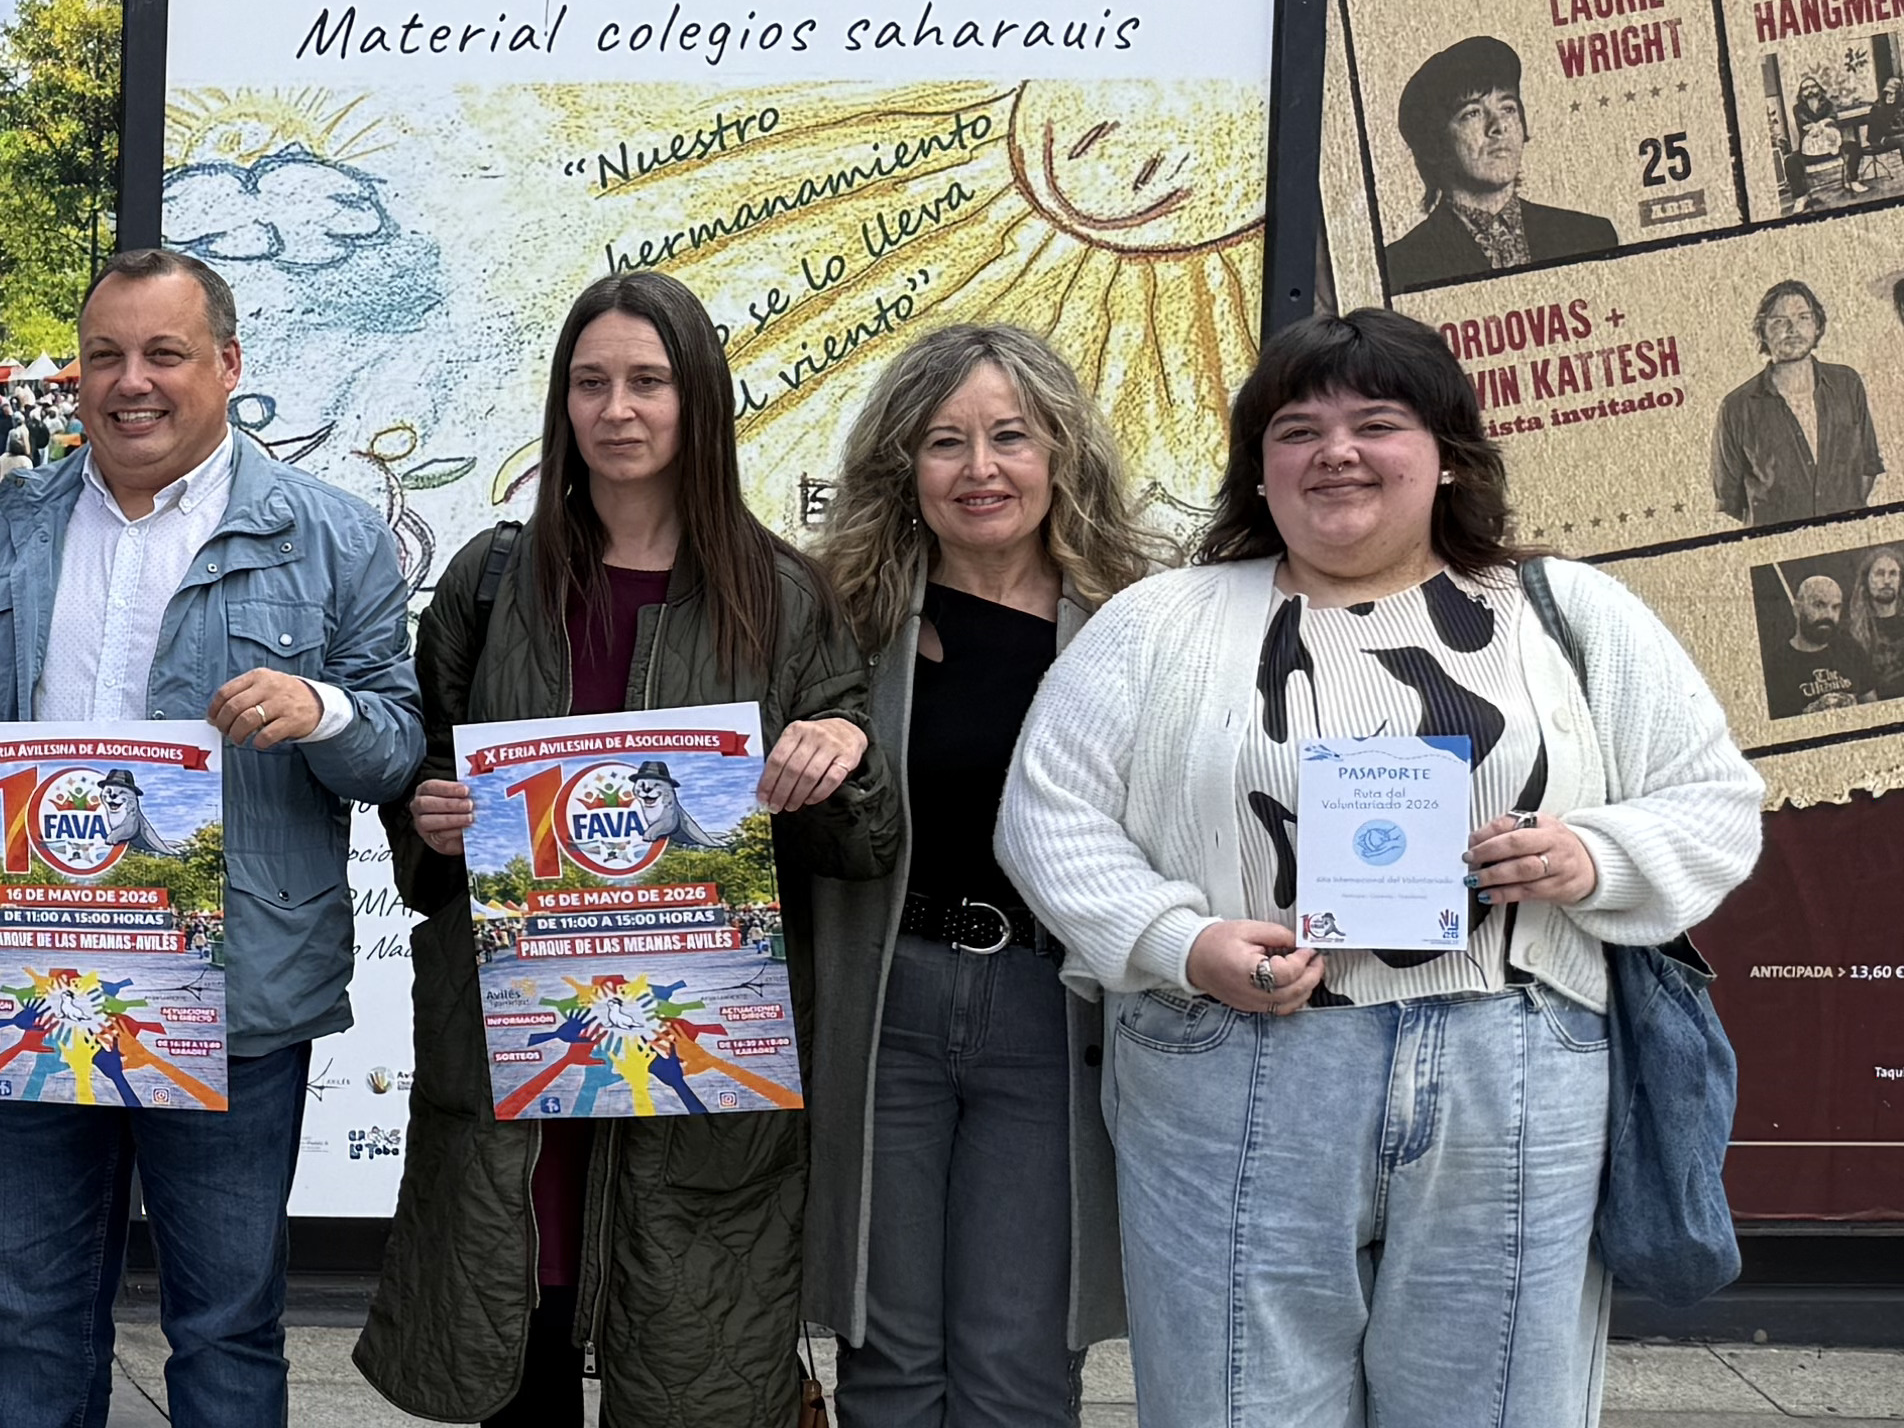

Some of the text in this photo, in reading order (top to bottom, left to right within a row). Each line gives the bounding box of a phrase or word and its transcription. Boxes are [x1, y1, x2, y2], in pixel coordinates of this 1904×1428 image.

[295, 1, 1142, 66] Material colegios saharauis
[1555, 17, 1683, 79] WRIGHT
[1638, 131, 1693, 188] 25
[605, 112, 992, 273] hermanamiento
[749, 179, 976, 334] se lo lleva
[1439, 298, 1593, 362] ORDOVAS
[1530, 335, 1681, 401] KATTESH
[1550, 386, 1686, 428] invitado)
[483, 749, 498, 766] X
[1338, 767, 1431, 781] PASAPORTE
[1322, 799, 1440, 810] Voluntariado 2026
[1354, 788, 1382, 799] Ruta
[43, 812, 109, 840] FAVA
[573, 810, 648, 840] FAVA
[5, 887, 159, 904] 16 DE MAYO DE 2026
[537, 886, 707, 910] 16 DE MAYO DE 2026
[537, 909, 715, 931] DE 11:00 A 15:00 HORAS
[520, 930, 734, 958] PARQUE DE LAS MEANAS-AVILÉS
[1749, 965, 1834, 979] ANTICIPADA
[1849, 965, 1892, 981] 13,60
